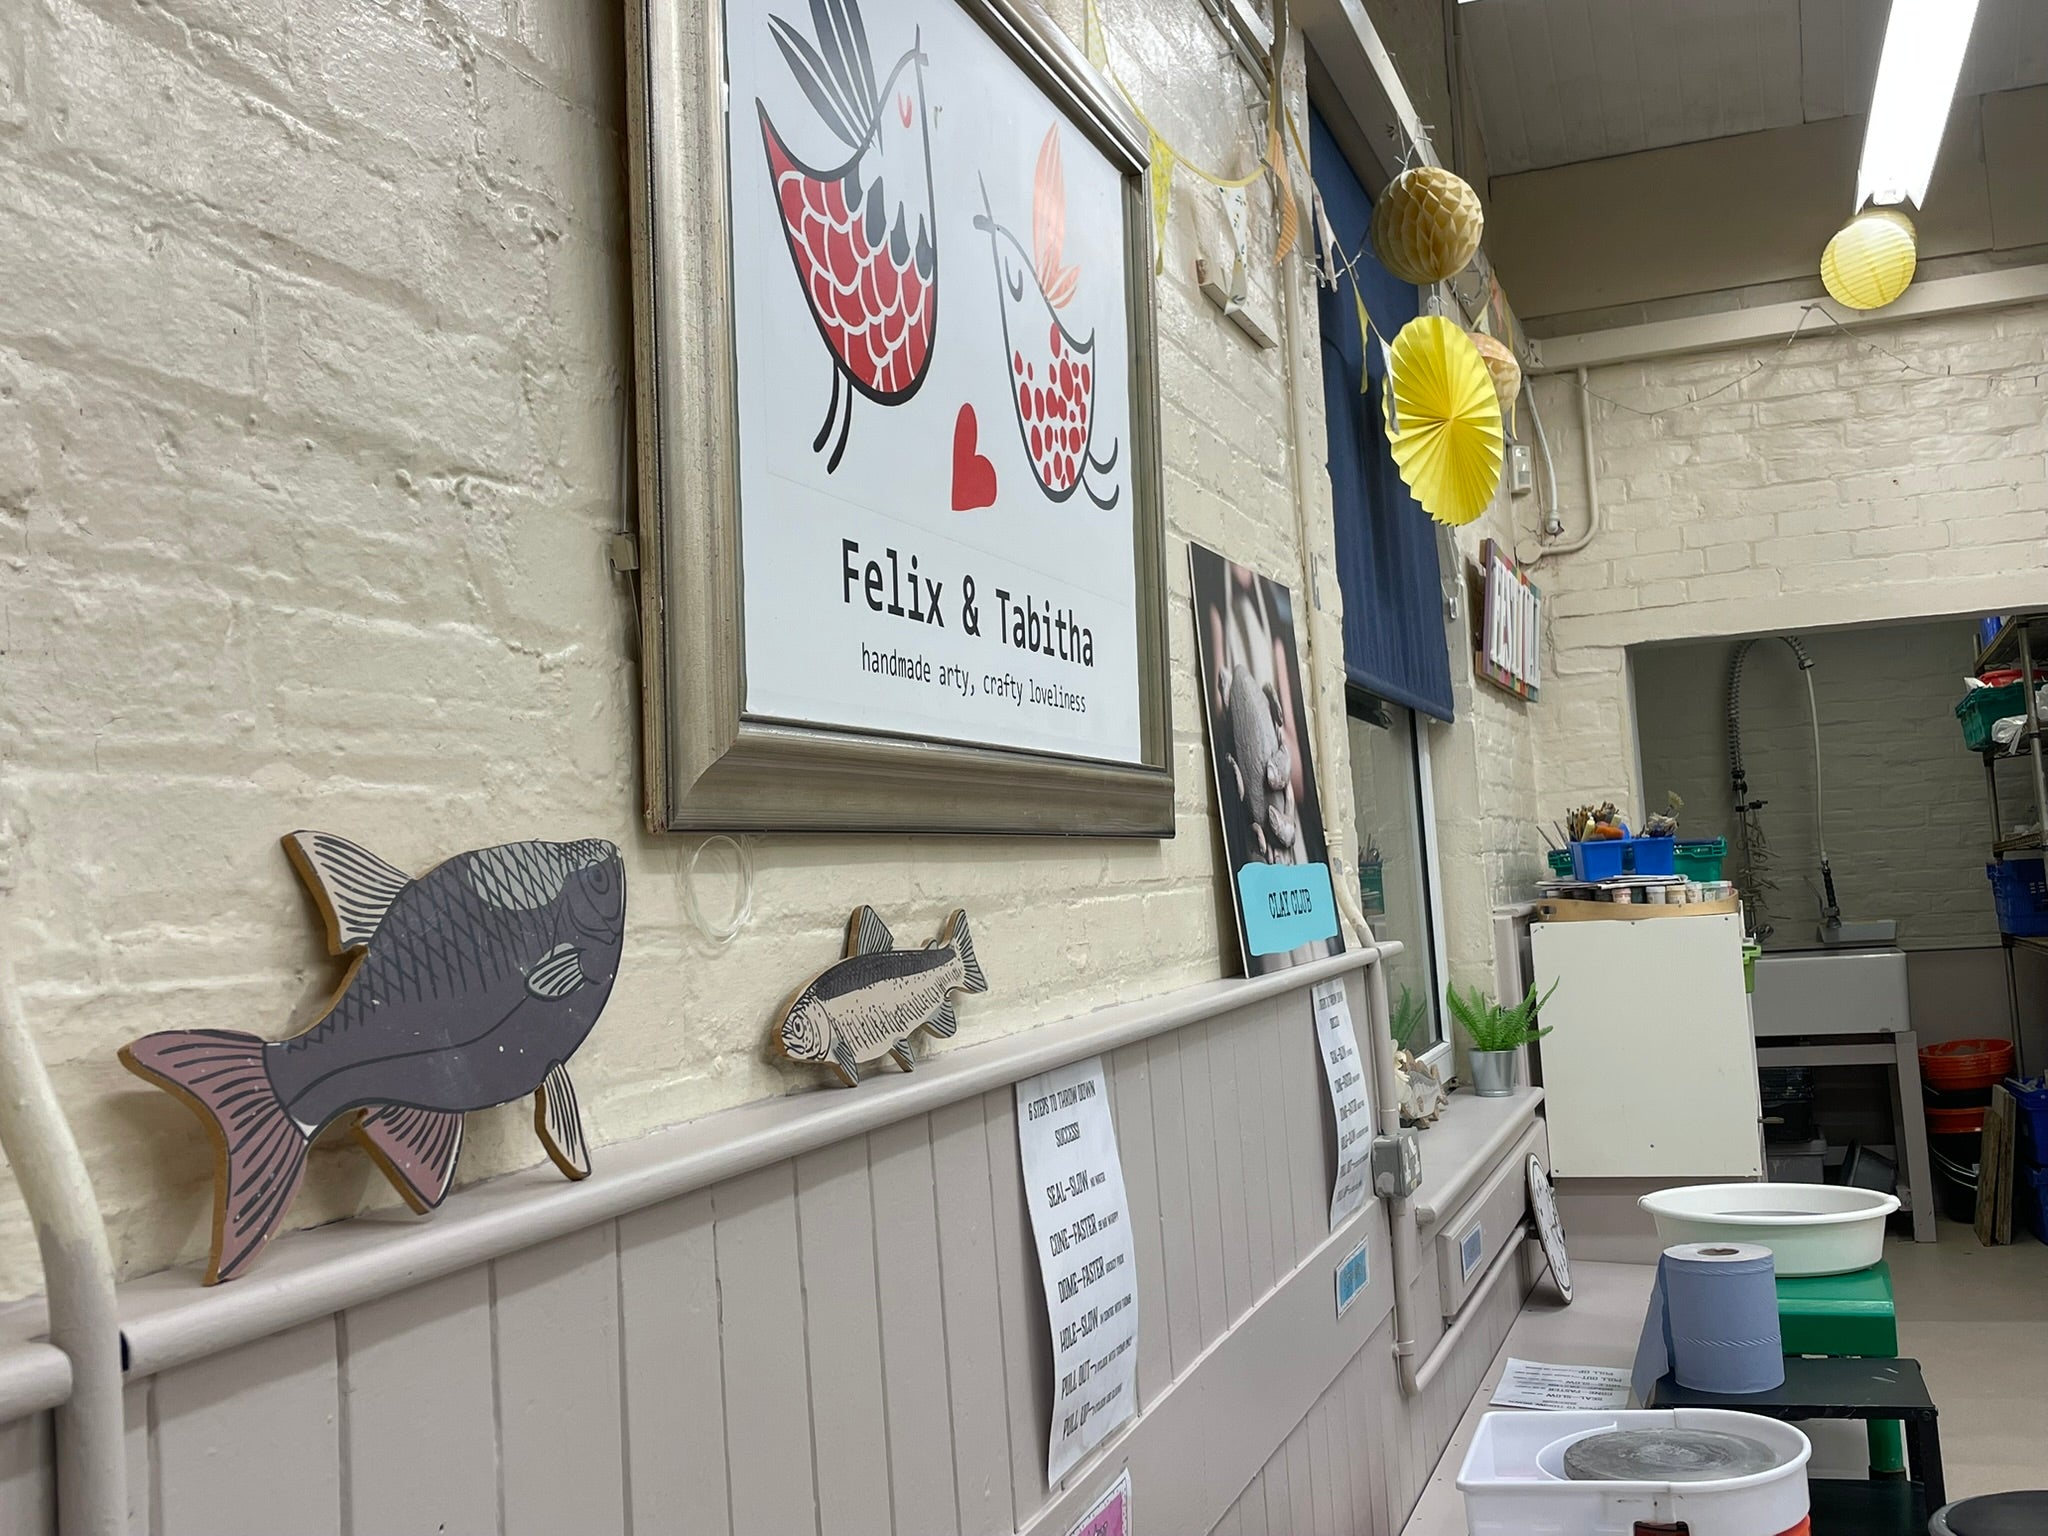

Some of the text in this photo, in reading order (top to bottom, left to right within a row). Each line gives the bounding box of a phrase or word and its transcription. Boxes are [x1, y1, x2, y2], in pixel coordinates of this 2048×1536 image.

[842, 538, 1094, 668] Felix & Tabitha
[861, 642, 1086, 713] handmade arty, crafty loveliness
[1268, 888, 1313, 919] CLAY CLUB
[1033, 1096, 1049, 1119] STEPS
[1049, 1093, 1058, 1112] TO
